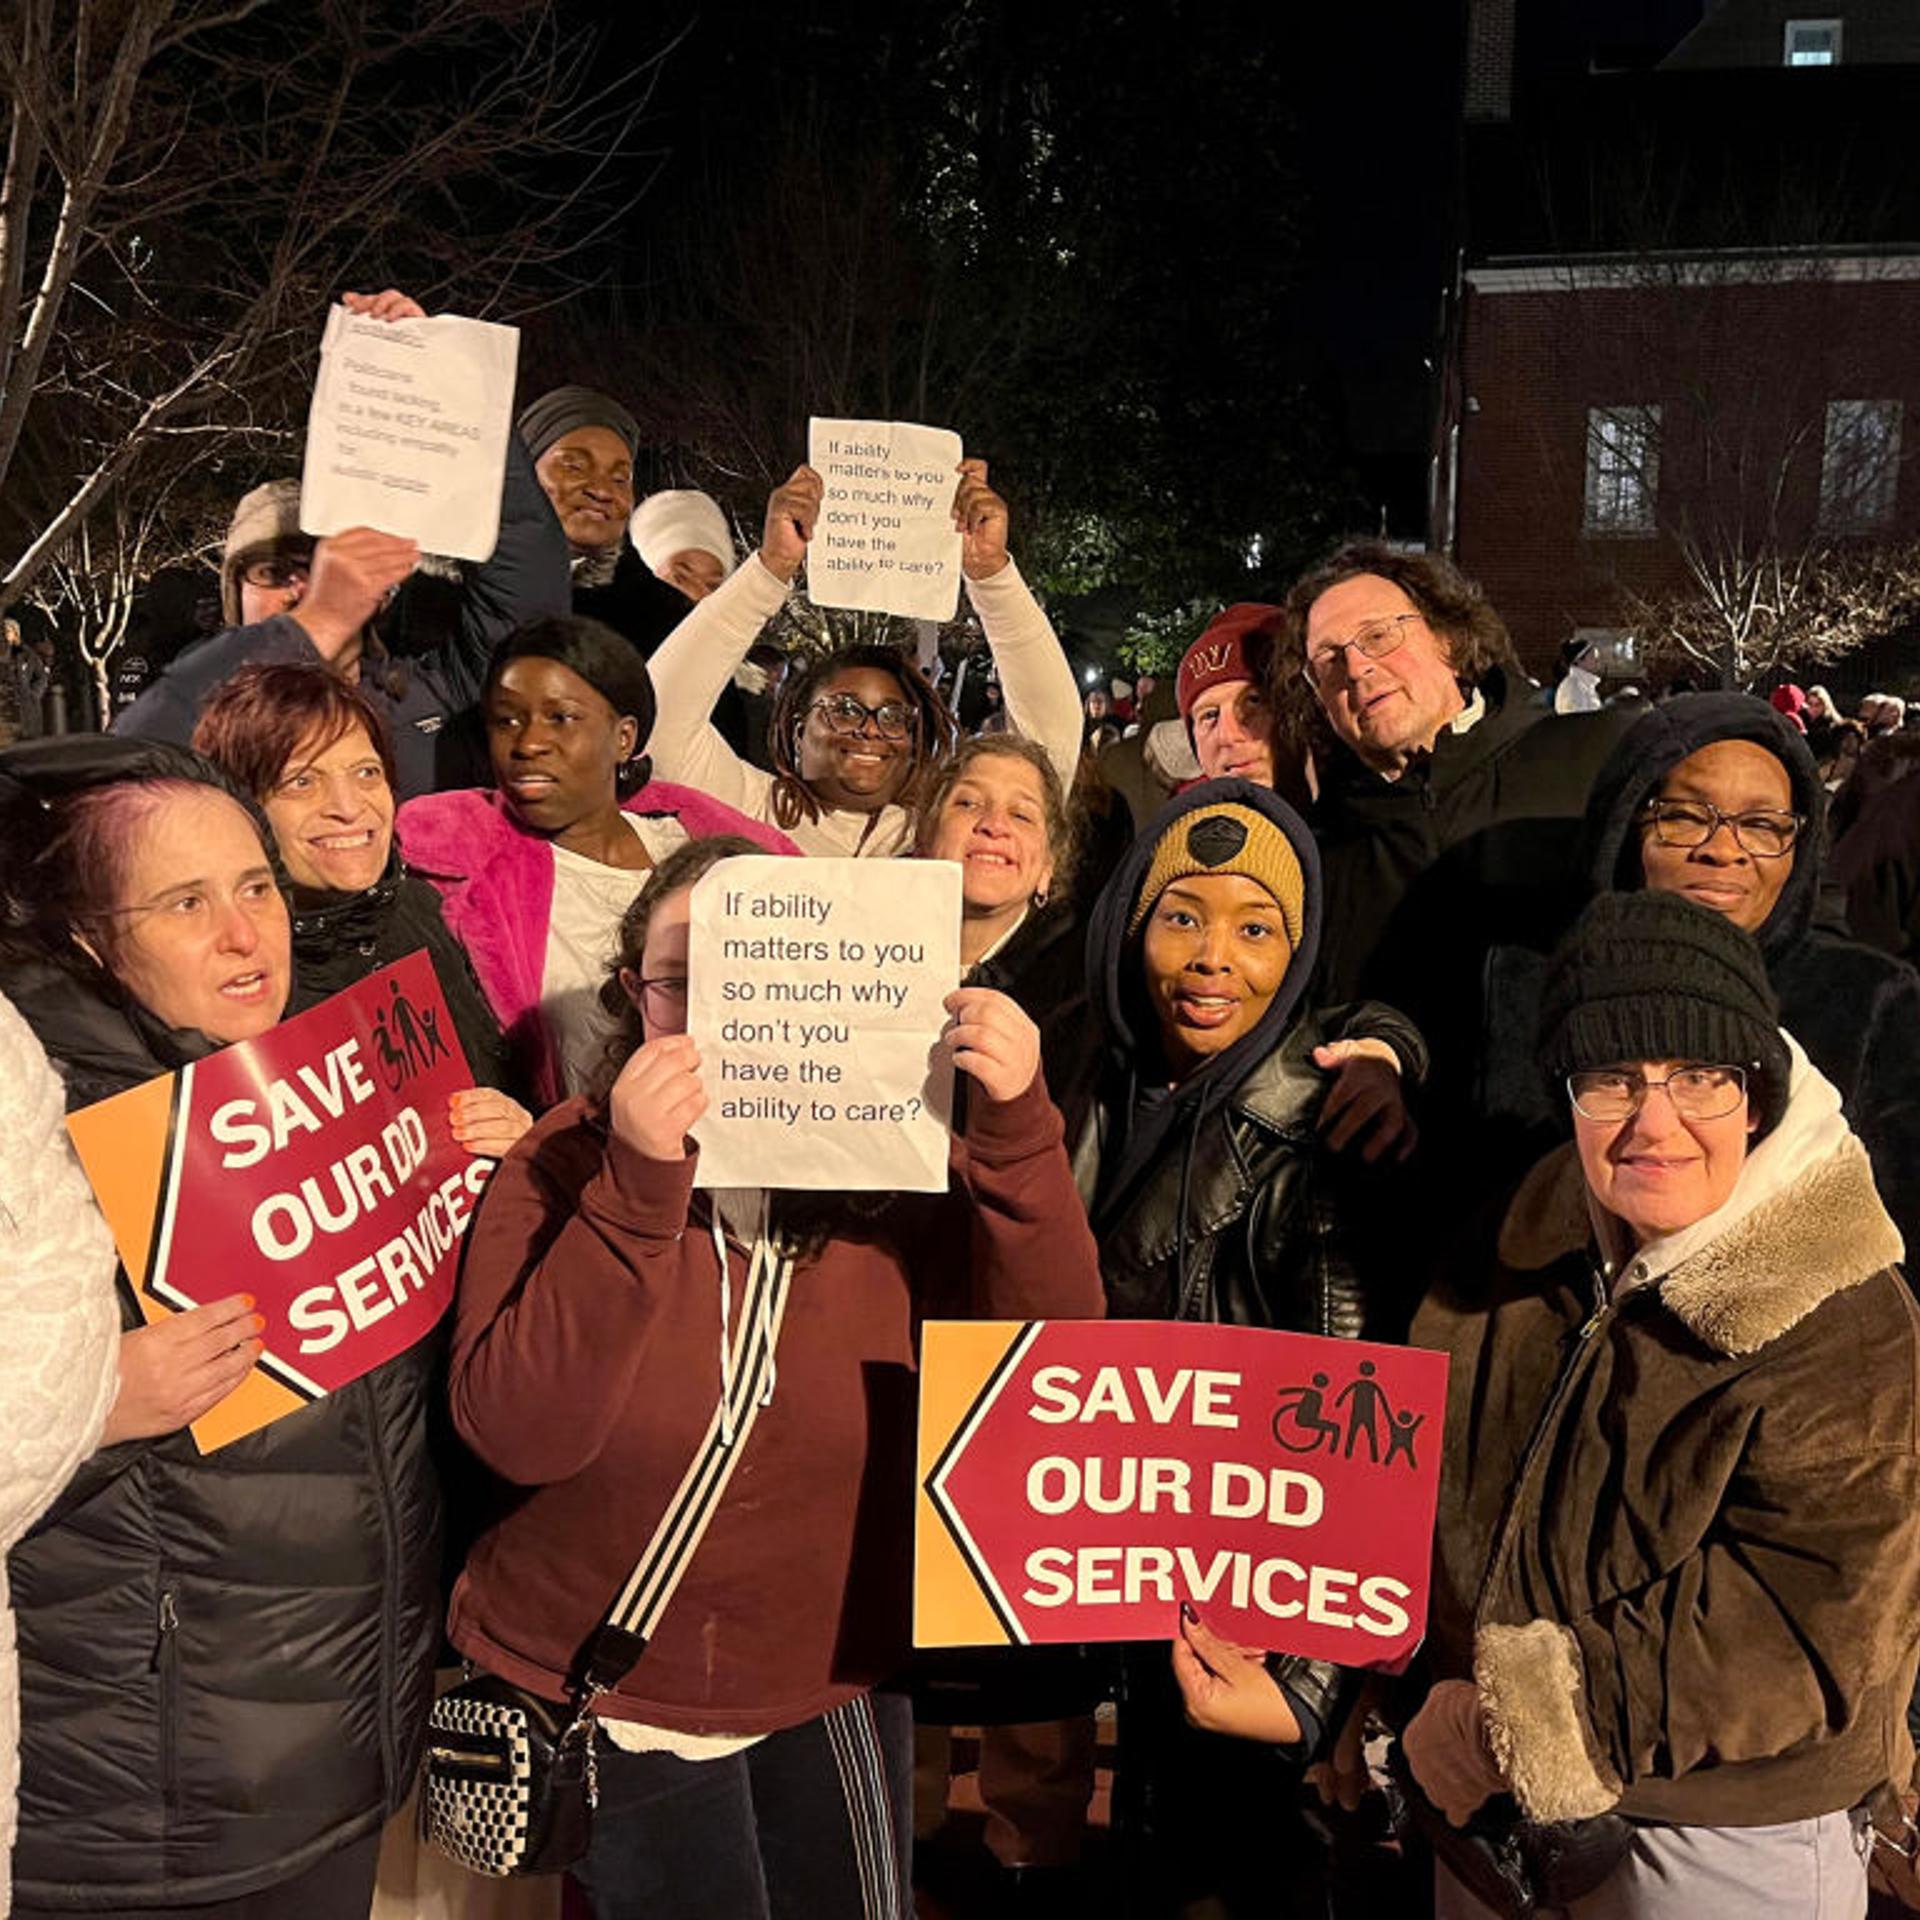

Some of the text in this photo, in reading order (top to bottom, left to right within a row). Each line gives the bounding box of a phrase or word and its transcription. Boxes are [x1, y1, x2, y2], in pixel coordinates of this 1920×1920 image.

[828, 441, 891, 462] If ability
[829, 464, 944, 485] matters to you
[827, 487, 934, 511] so much why
[871, 515, 901, 531] you
[827, 533, 896, 551] have the
[827, 557, 944, 576] ability to care?
[724, 891, 832, 925] If ability
[723, 938, 924, 968] matters to you
[721, 979, 909, 1008] so much why
[721, 1018, 849, 1048] don't you
[721, 1058, 842, 1084] have the
[209, 1036, 376, 1169] SAVE
[721, 1096, 922, 1126] ability to care?
[251, 1105, 429, 1261] OUR DD
[288, 1159, 496, 1355] SERVICES
[1027, 1365, 1242, 1429] SAVE
[1026, 1456, 1325, 1529] OUR DD
[1022, 1546, 1412, 1639] SERVICES
